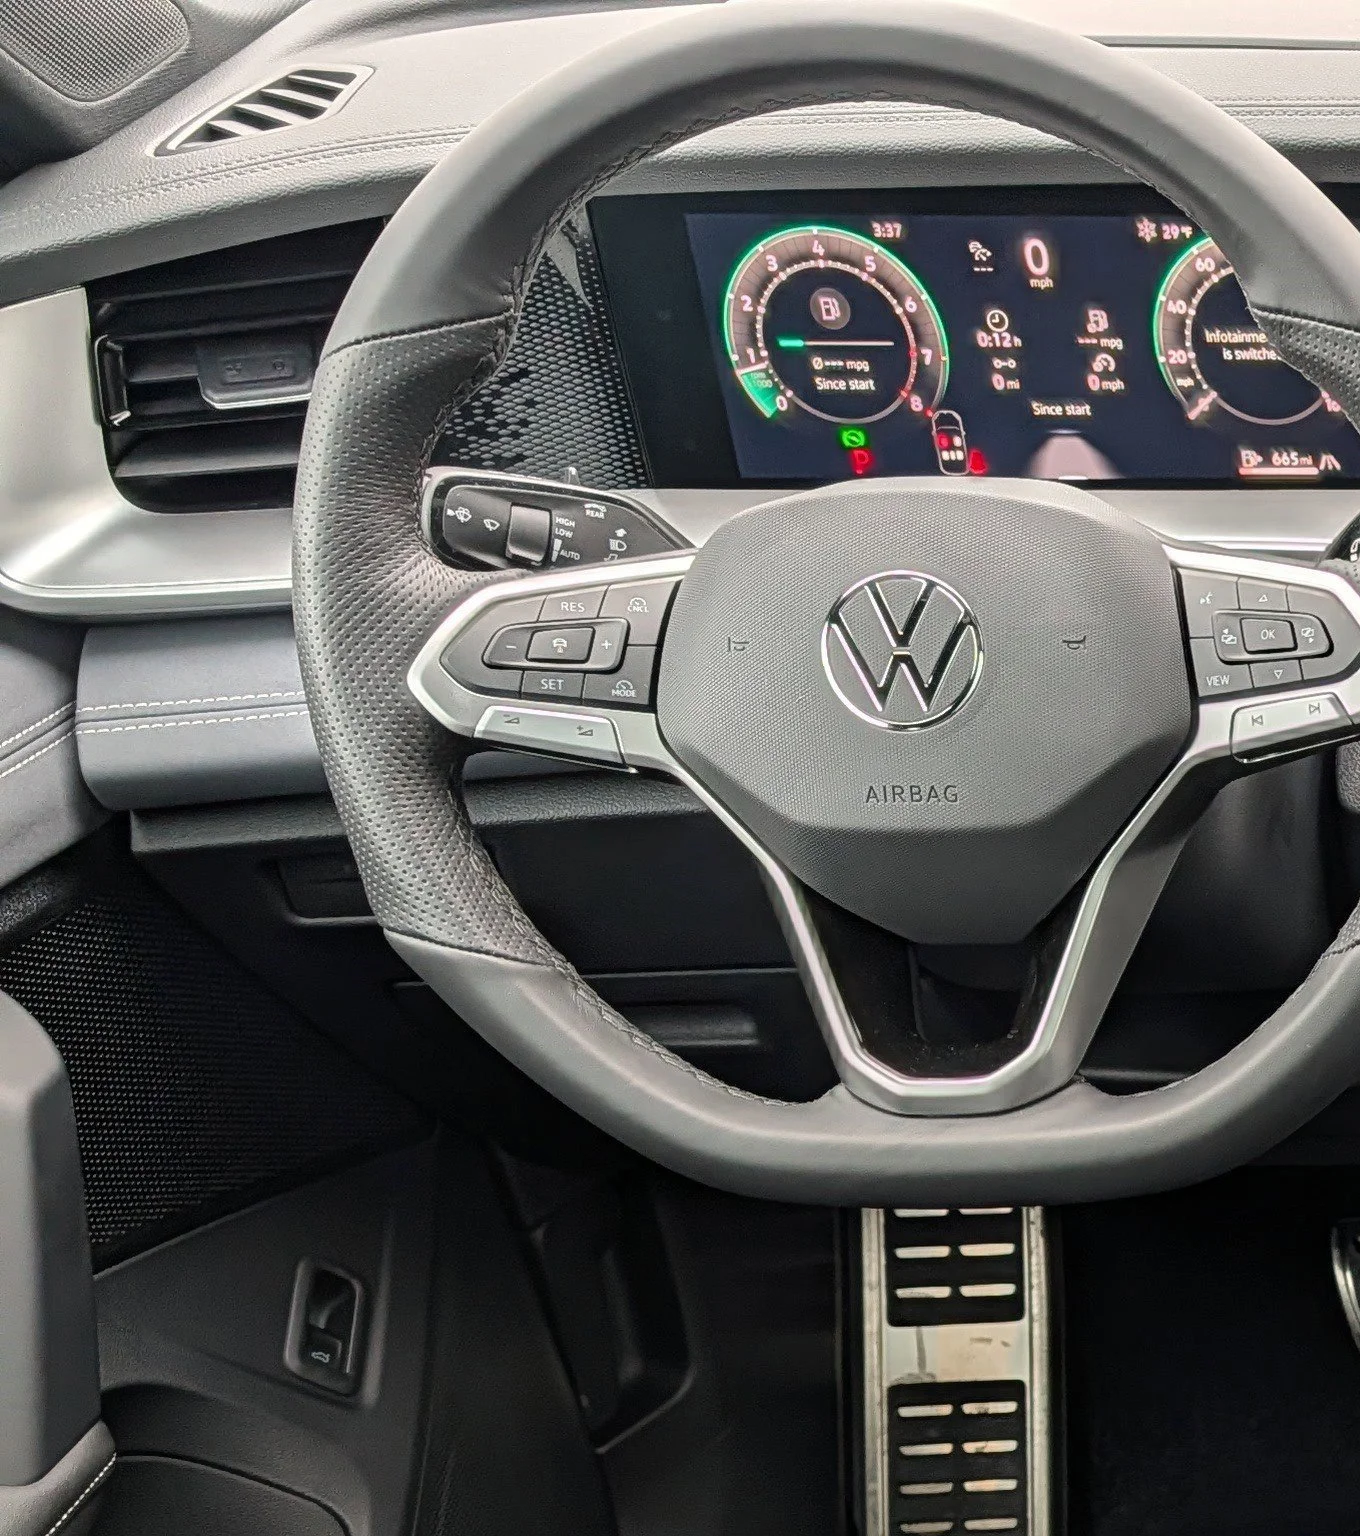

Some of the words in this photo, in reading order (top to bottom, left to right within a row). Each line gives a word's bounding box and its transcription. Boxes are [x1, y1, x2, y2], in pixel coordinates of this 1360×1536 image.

[872, 222, 902, 239] 3:37
[1162, 223, 1180, 240] 29
[812, 240, 825, 256] 4
[766, 254, 779, 271] 3
[864, 255, 877, 272] 5
[1023, 238, 1050, 276] 0
[1195, 257, 1216, 272] 60
[1030, 278, 1053, 290] mph
[741, 295, 753, 312] 2
[902, 296, 917, 313] 6
[1167, 300, 1187, 315] 40
[976, 331, 1012, 348] 0:12
[1100, 337, 1123, 350] mpg
[1205, 329, 1268, 343] Infotainme
[746, 348, 756, 363] 1
[921, 349, 933, 365] 7
[1168, 350, 1188, 364] 20
[1222, 348, 1233, 360] is
[1234, 348, 1277, 360] switche
[846, 360, 869, 372] mpg
[815, 377, 846, 390] Since
[849, 378, 875, 390] start
[991, 373, 1005, 391] 0
[1007, 378, 1020, 390] mi
[1087, 373, 1100, 391] 0
[1101, 378, 1125, 392] mph
[776, 395, 788, 411] 0
[910, 395, 923, 411] 8
[1031, 402, 1062, 416] Since
[1065, 402, 1091, 416] start
[1271, 450, 1299, 466] 665
[555, 516, 576, 528] HIGH
[585, 509, 605, 520] REAR
[555, 527, 574, 538] LOW
[560, 549, 581, 560] AUTO
[560, 601, 585, 613] RES
[627, 605, 649, 613] CNCL
[1261, 629, 1276, 640] OK
[541, 678, 565, 690] SET
[1206, 675, 1230, 687] VIEW
[611, 689, 637, 698] MODE
[866, 784, 959, 804] AIRBAG
